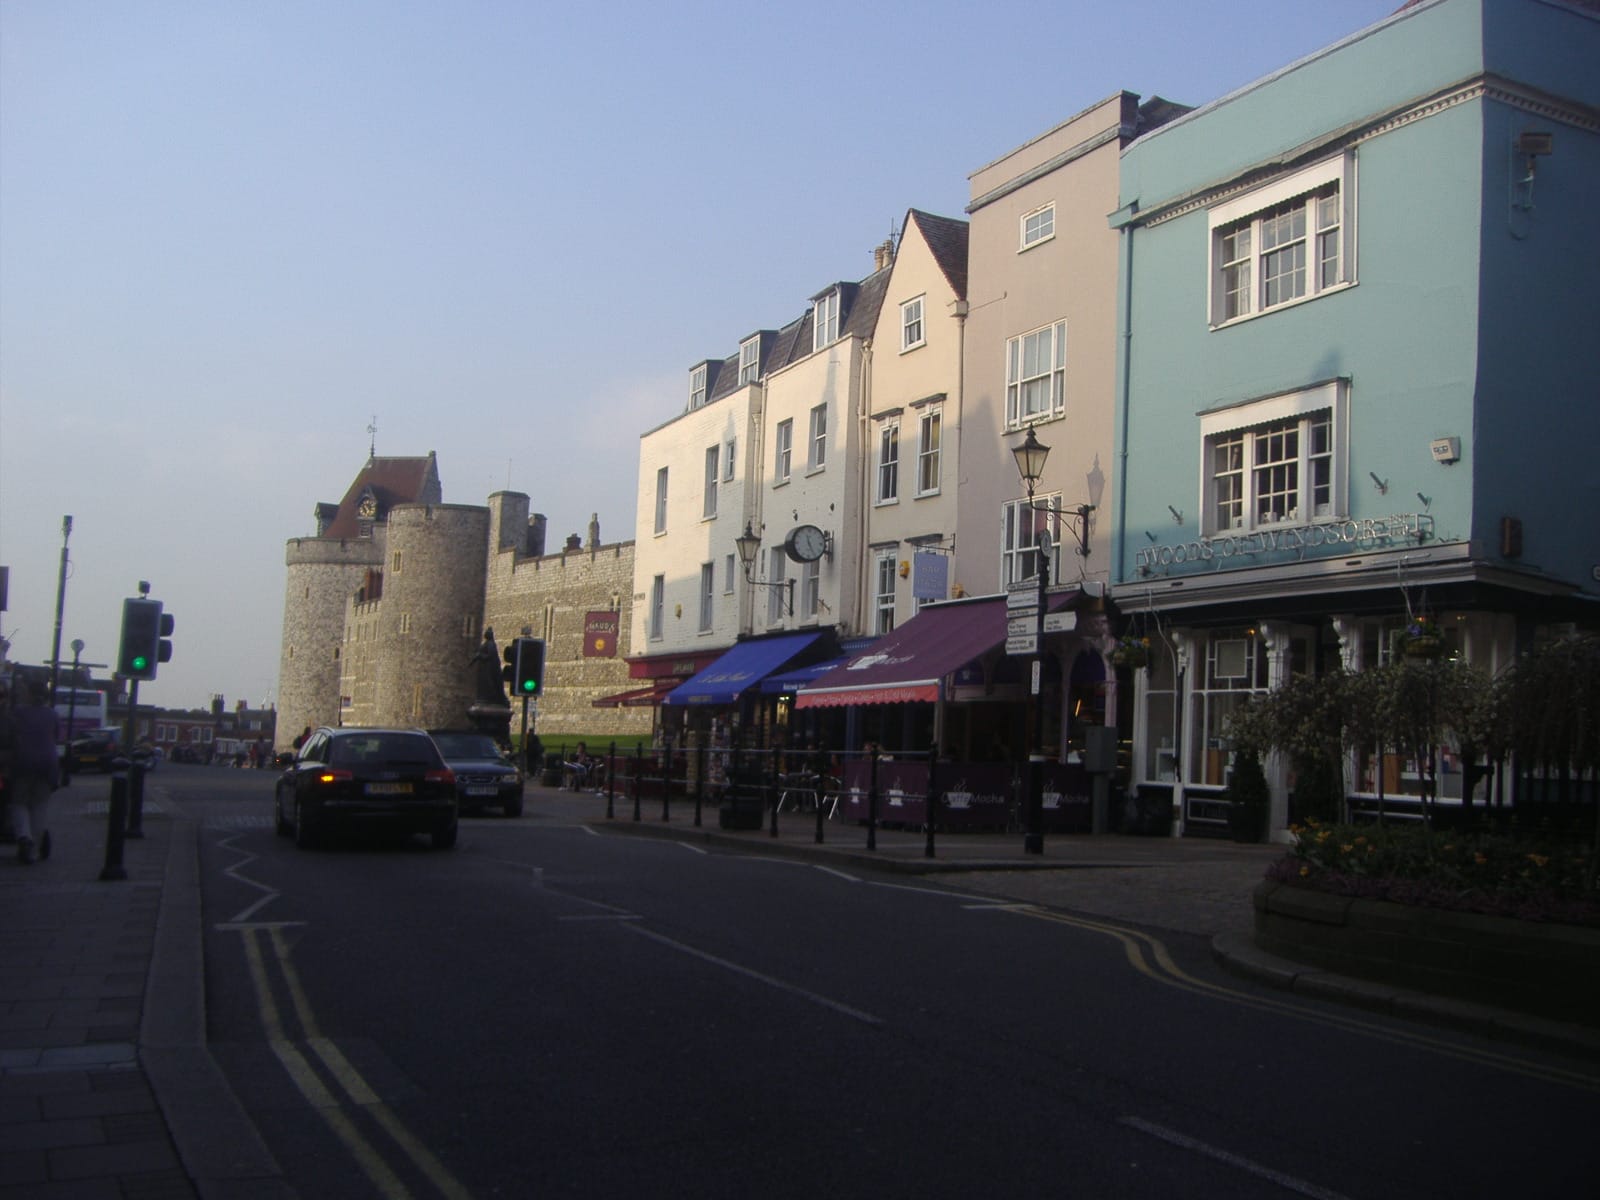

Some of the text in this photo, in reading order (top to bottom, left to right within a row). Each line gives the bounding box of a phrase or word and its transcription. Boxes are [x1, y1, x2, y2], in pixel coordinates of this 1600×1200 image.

[1142, 540, 1214, 566] WOODS
[1223, 535, 1253, 557] OF
[1258, 518, 1377, 552] WINDSOR
